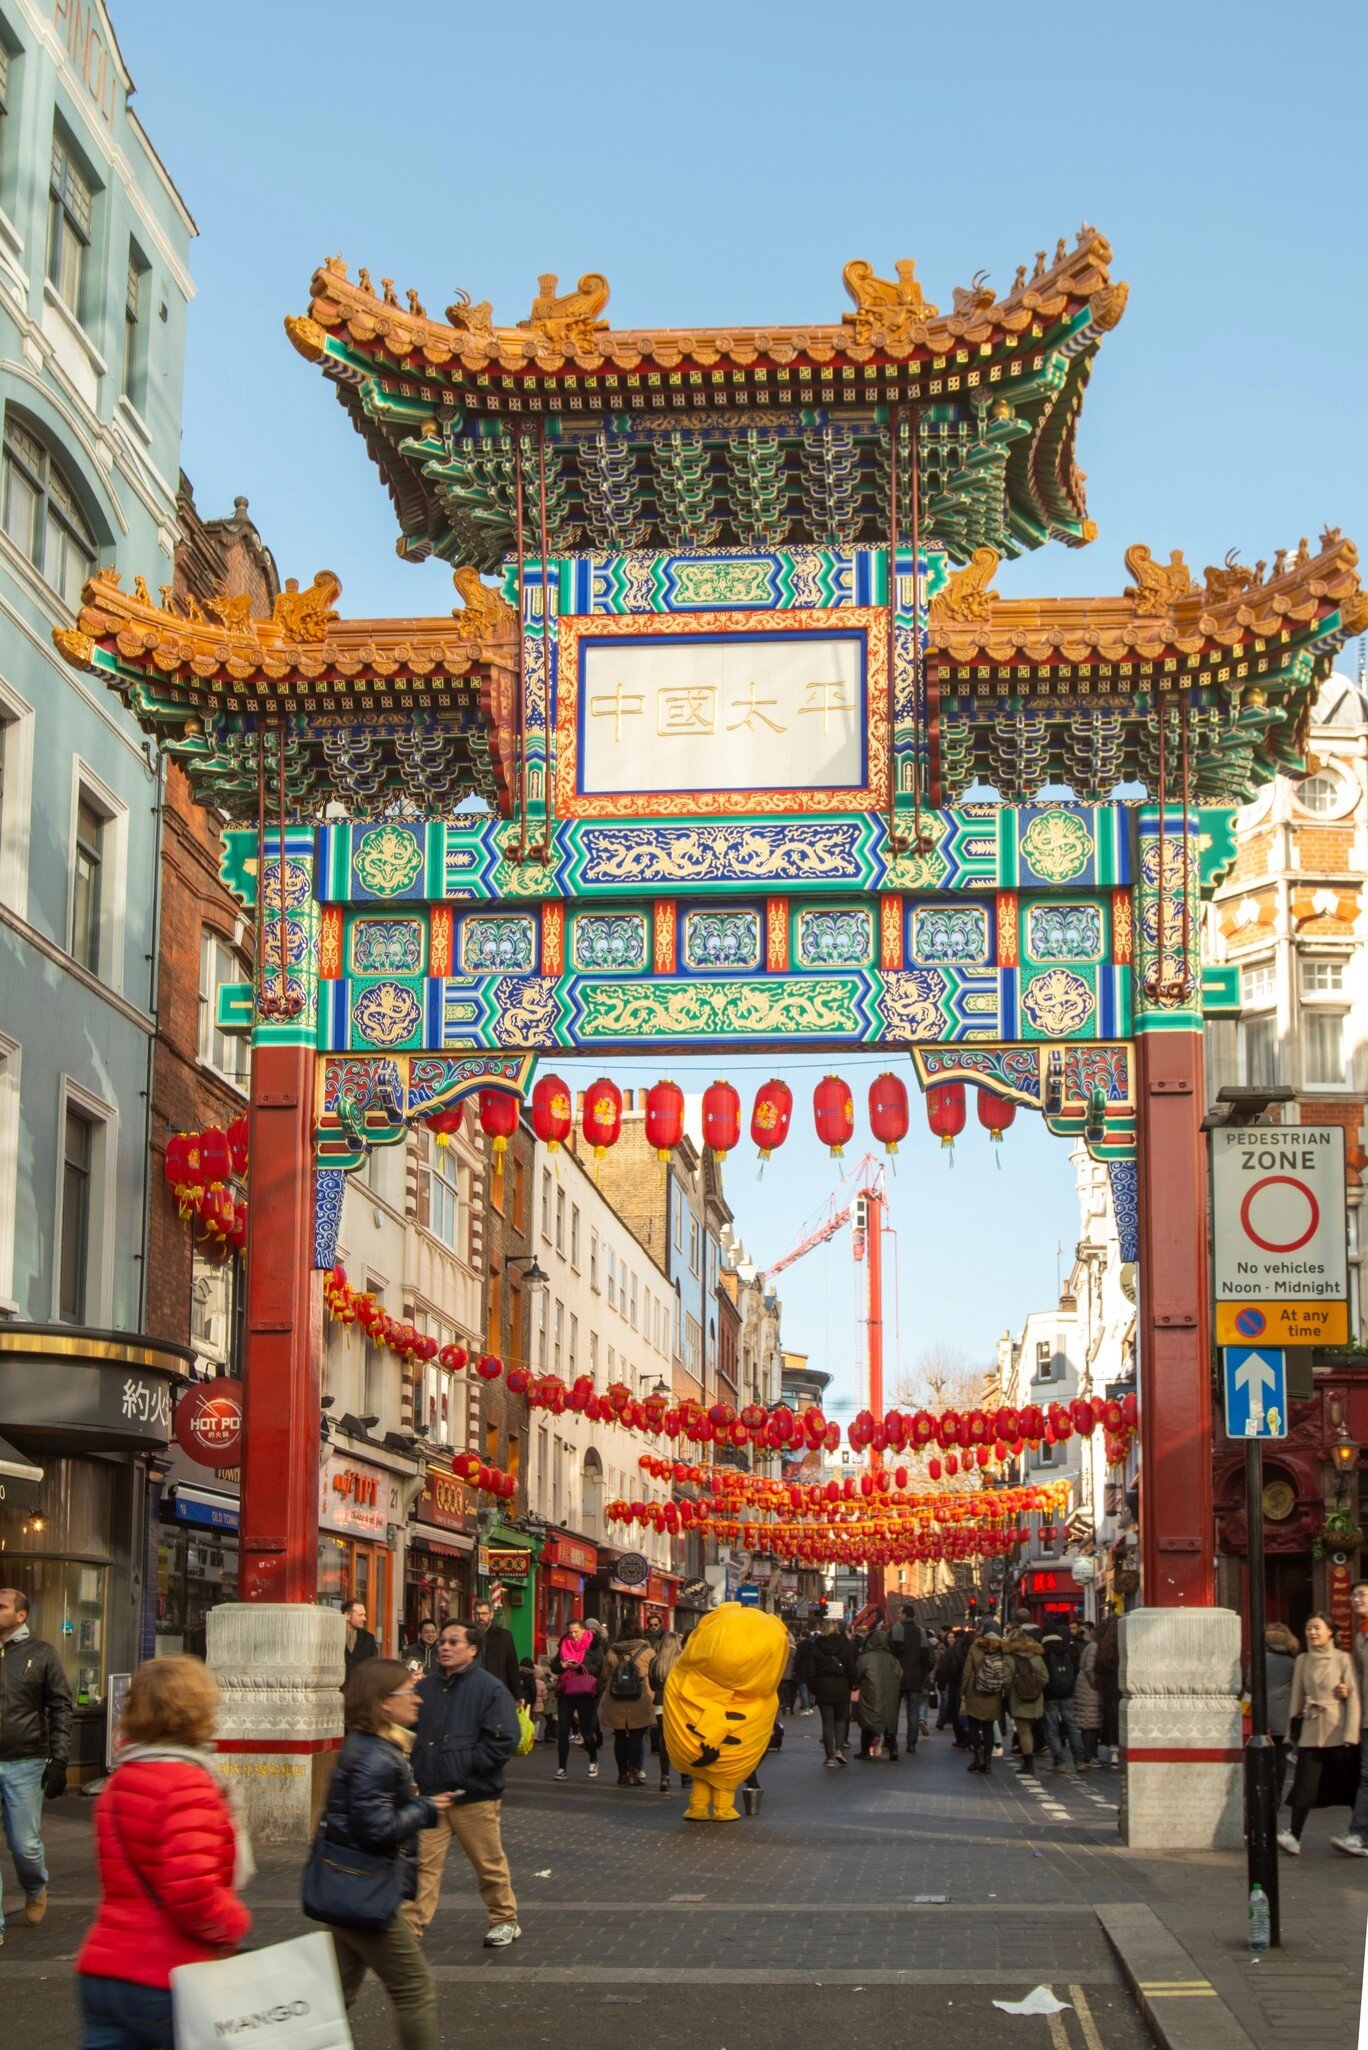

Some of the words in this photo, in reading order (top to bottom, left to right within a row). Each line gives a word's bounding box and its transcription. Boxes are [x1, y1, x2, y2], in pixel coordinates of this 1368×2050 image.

[590, 681, 857, 742] 中國太平
[1226, 1132, 1331, 1146] PEDESTRIAN
[1241, 1151, 1315, 1170] ZONE
[1237, 1262, 1258, 1274] No
[1263, 1261, 1325, 1274] vehicles
[1222, 1281, 1262, 1294] Noon
[1274, 1280, 1341, 1297] Midnight
[1280, 1309, 1299, 1321] At
[1302, 1311, 1329, 1325] any
[1288, 1324, 1322, 1337] time
[122, 1378, 170, 1427] 約火
[190, 1418, 218, 1431] HOT
[214, 2000, 311, 2038] MANGO
